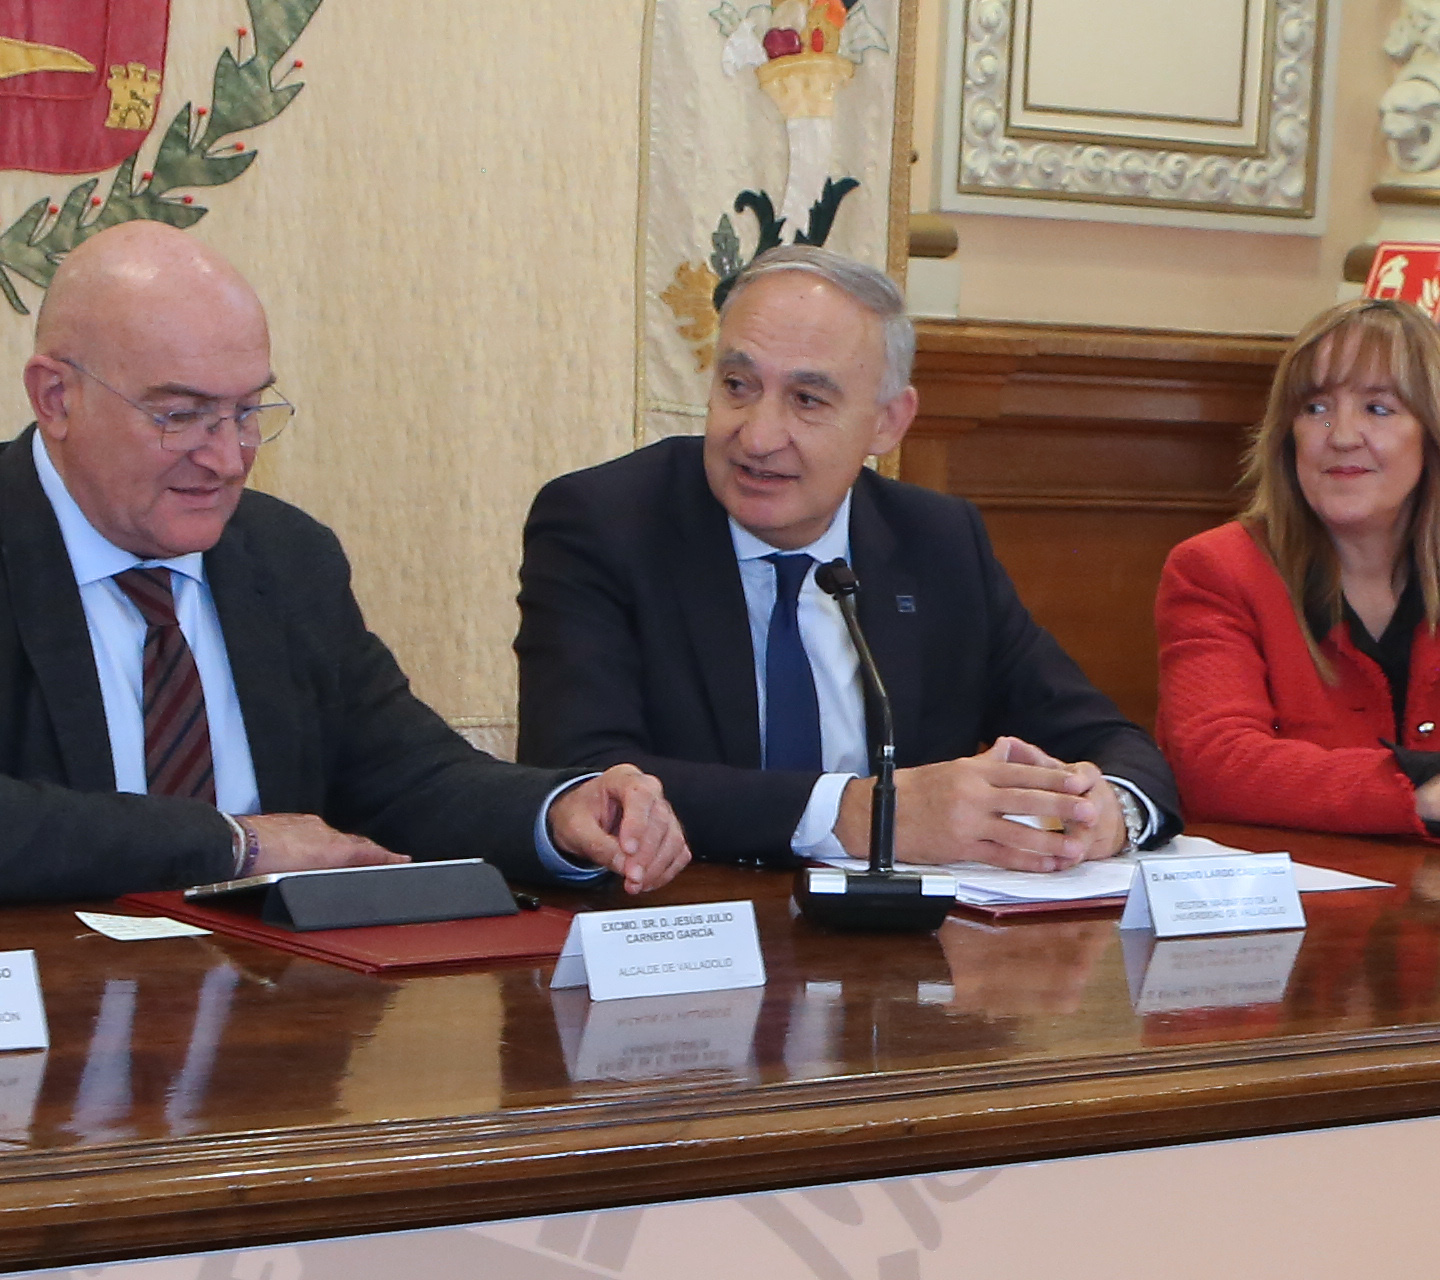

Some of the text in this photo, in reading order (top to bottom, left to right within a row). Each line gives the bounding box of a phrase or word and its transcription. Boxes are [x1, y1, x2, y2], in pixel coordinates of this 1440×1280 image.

[601, 912, 733, 933] EXCMO. SR. D. JESÚS JULIO
[625, 925, 715, 944] CARNERO GARCÍA
[662, 963, 676, 974] DE
